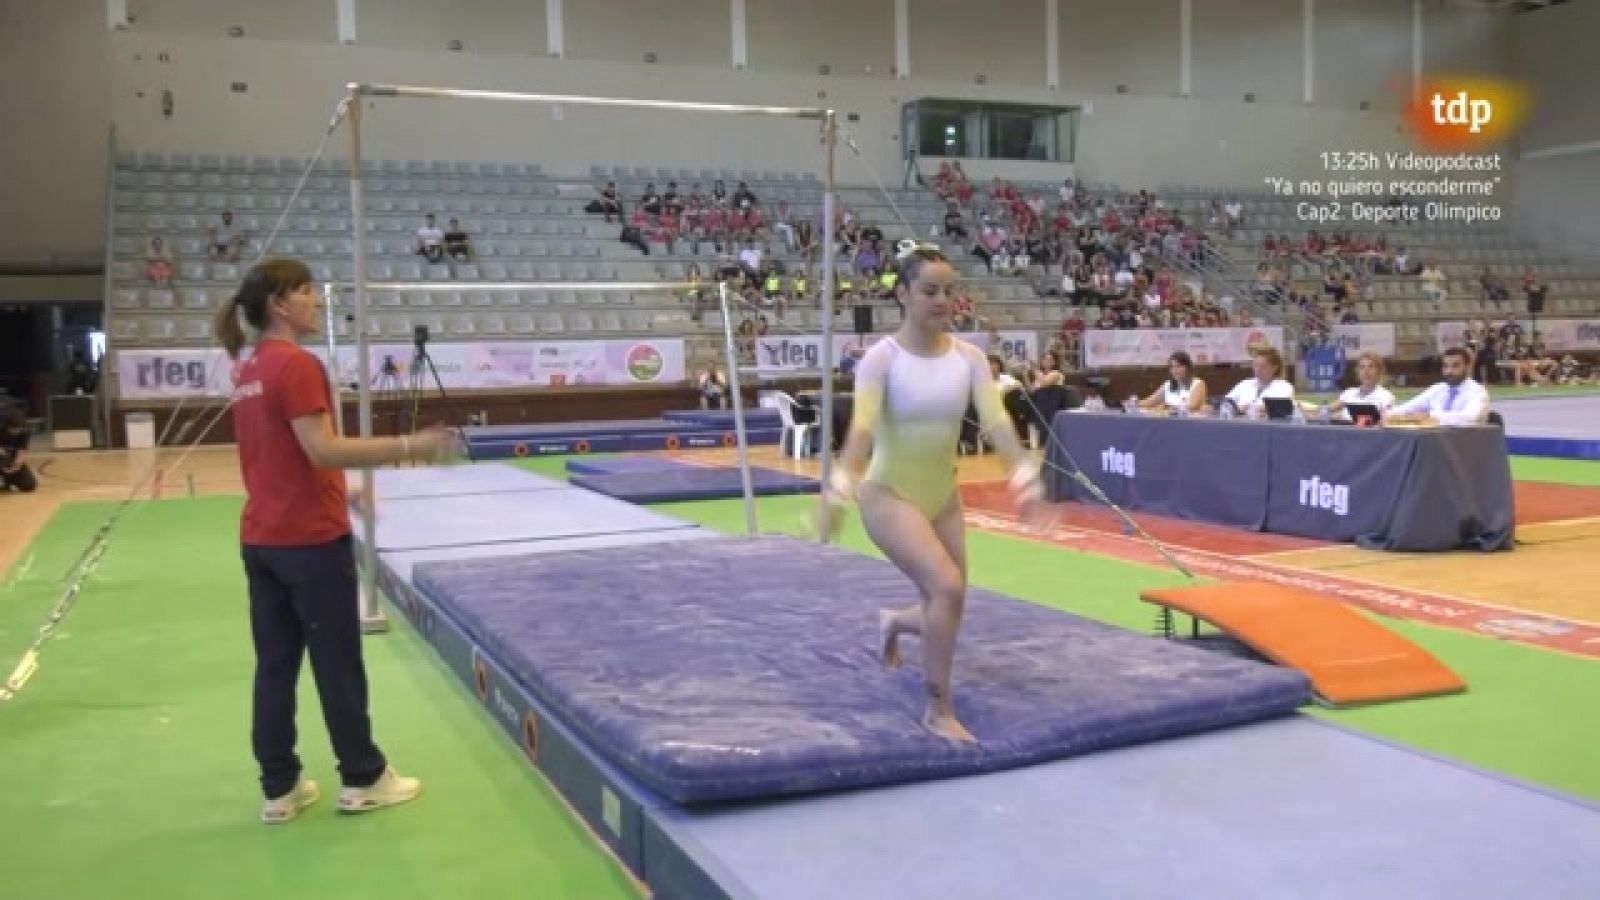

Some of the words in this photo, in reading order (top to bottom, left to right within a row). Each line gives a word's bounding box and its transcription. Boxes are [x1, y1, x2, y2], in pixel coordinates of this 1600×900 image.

[136, 357, 206, 389] rfeg
[1101, 446, 1136, 478] rfeg
[1299, 474, 1348, 516] rfeg
